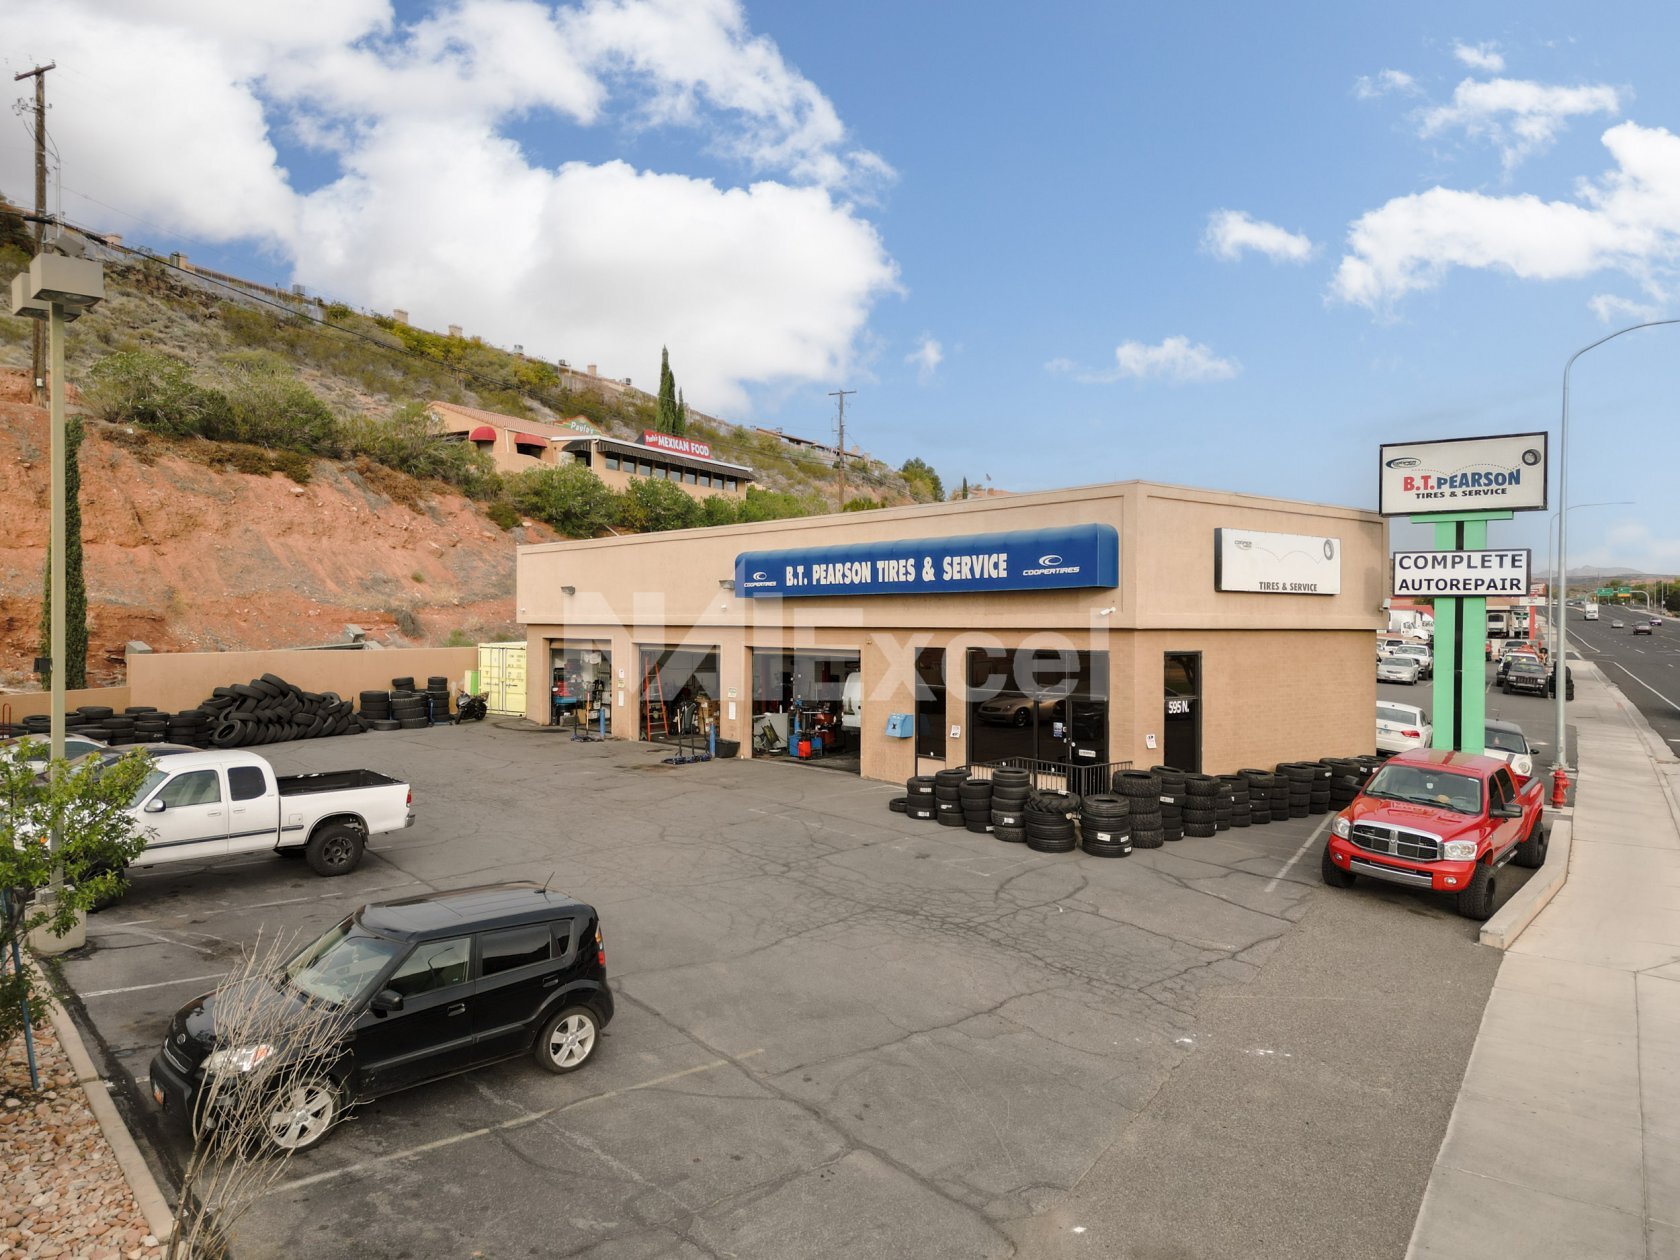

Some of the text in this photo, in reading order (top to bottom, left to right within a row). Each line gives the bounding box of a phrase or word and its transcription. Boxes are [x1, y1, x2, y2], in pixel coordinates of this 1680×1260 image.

[658, 435, 690, 452] MEXICAN
[690, 442, 710, 456] FOOD
[1415, 487, 1508, 500] TIRES & SERVICE
[1398, 553, 1524, 570] COMPLETE
[786, 553, 1008, 586] B.T. PEARSON TIRES & SERVICE
[1259, 581, 1318, 592] TIRES & SERVICE
[1398, 578, 1522, 591] AUTOREPAIR
[1168, 701, 1182, 714] 595
